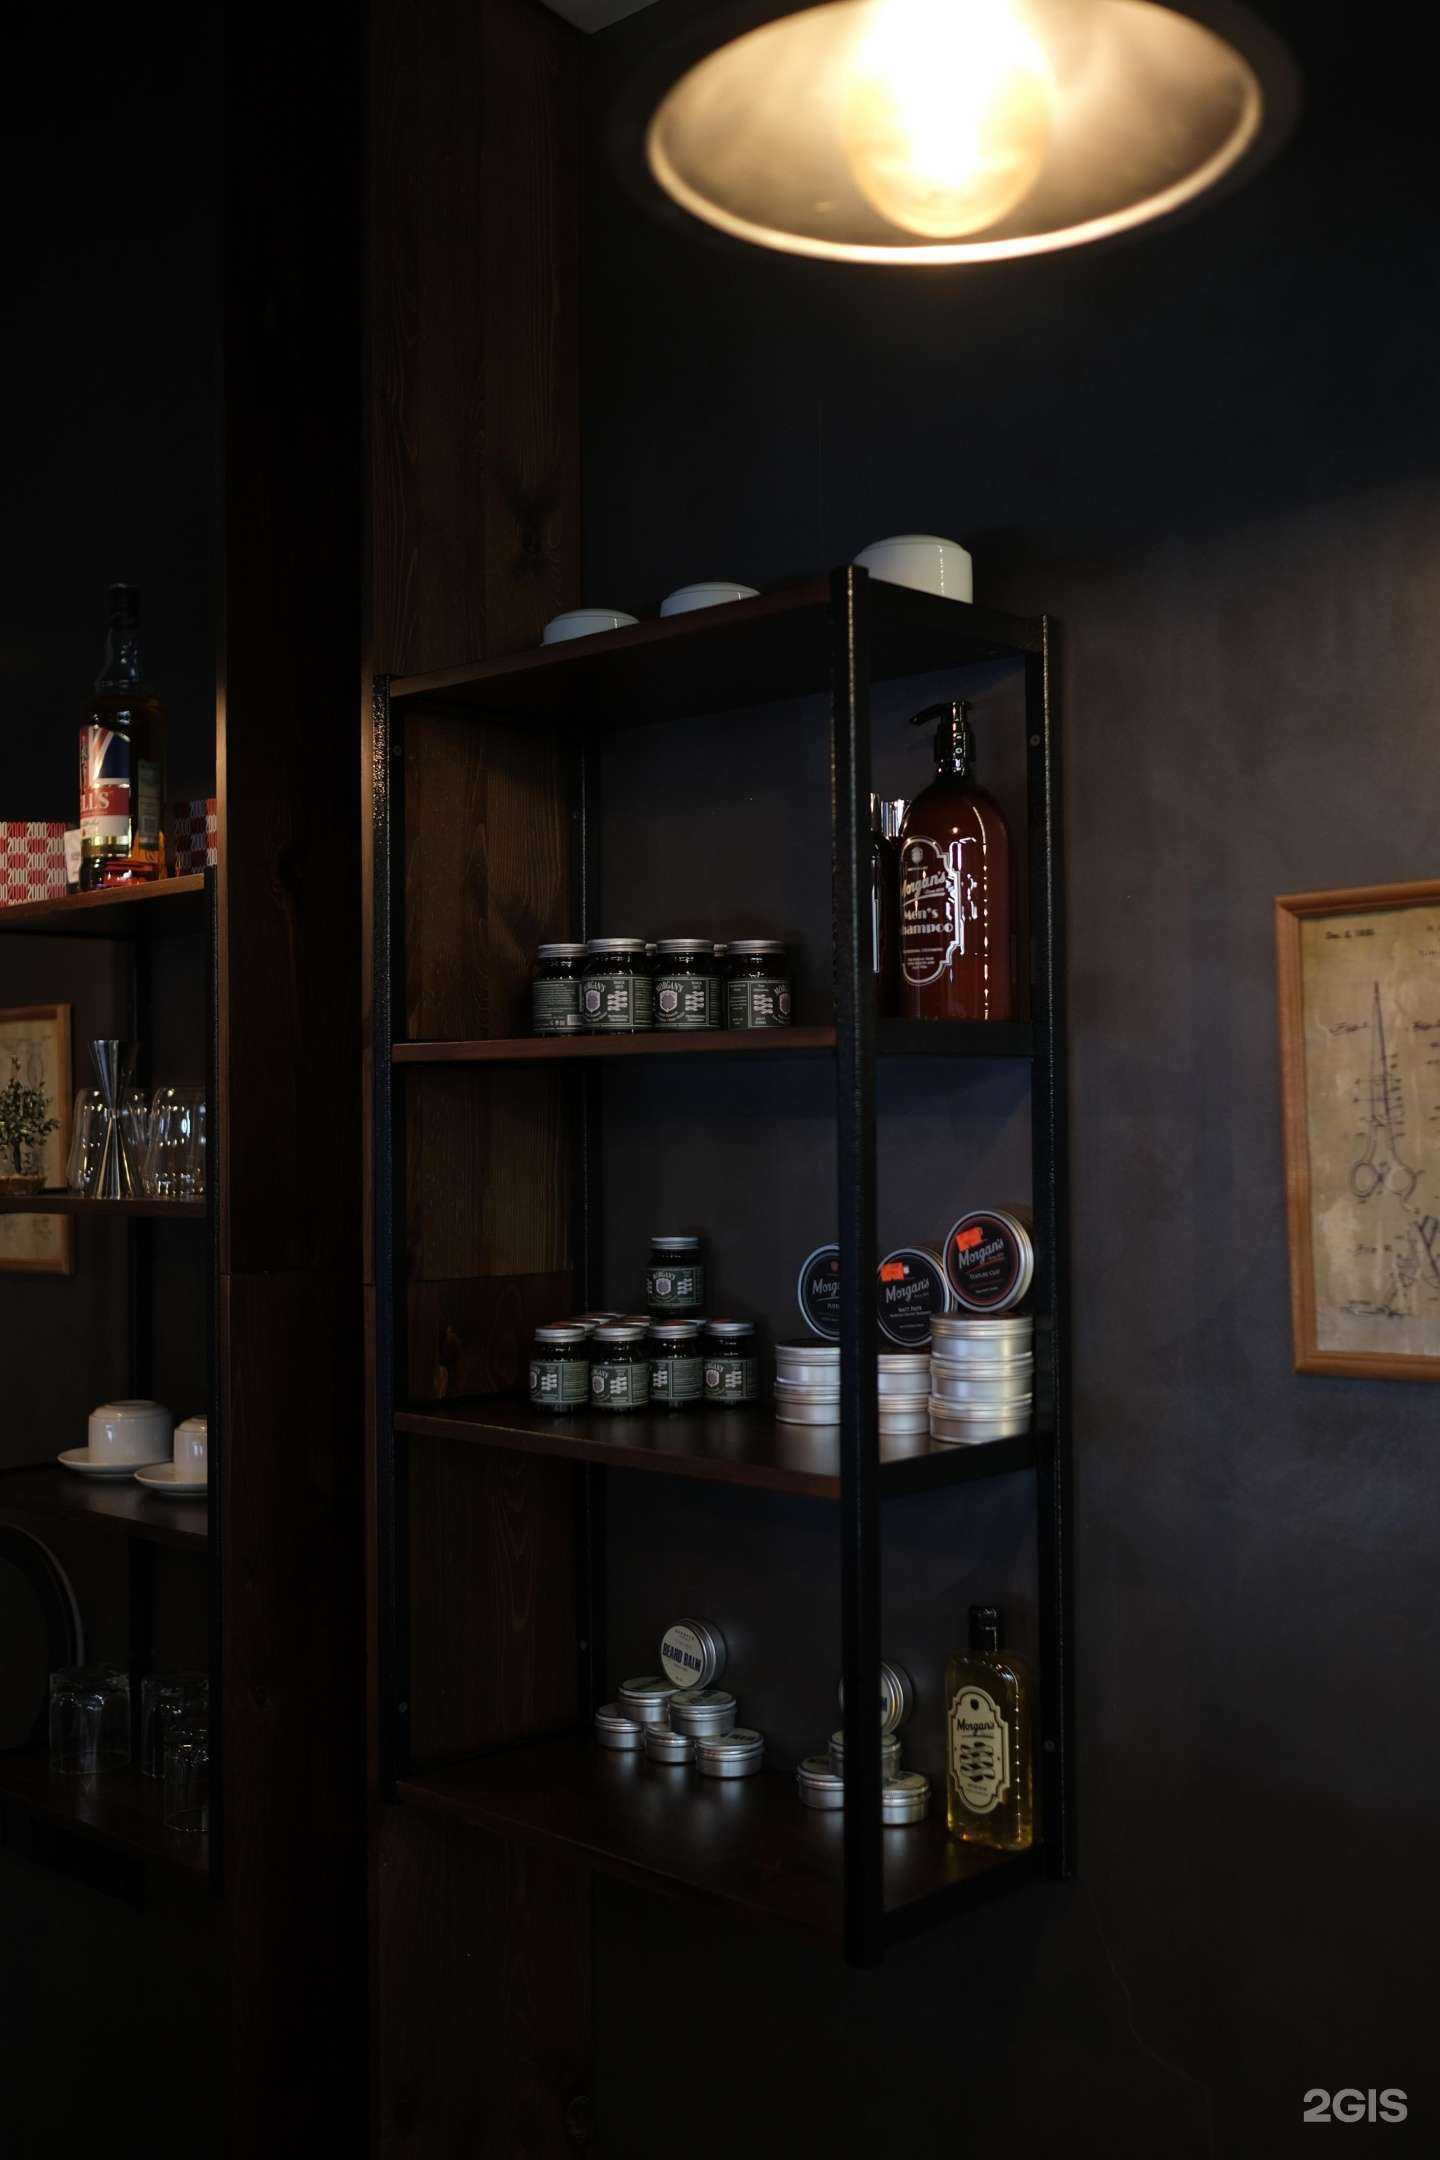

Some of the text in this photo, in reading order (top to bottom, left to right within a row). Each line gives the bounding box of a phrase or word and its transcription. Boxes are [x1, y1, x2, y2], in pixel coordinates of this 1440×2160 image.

[958, 1238, 1005, 1269] Morgan's
[885, 1278, 930, 1303] Morgan's
[662, 1642, 702, 1672] BEARD BALM
[957, 1718, 995, 1736] Morgan's
